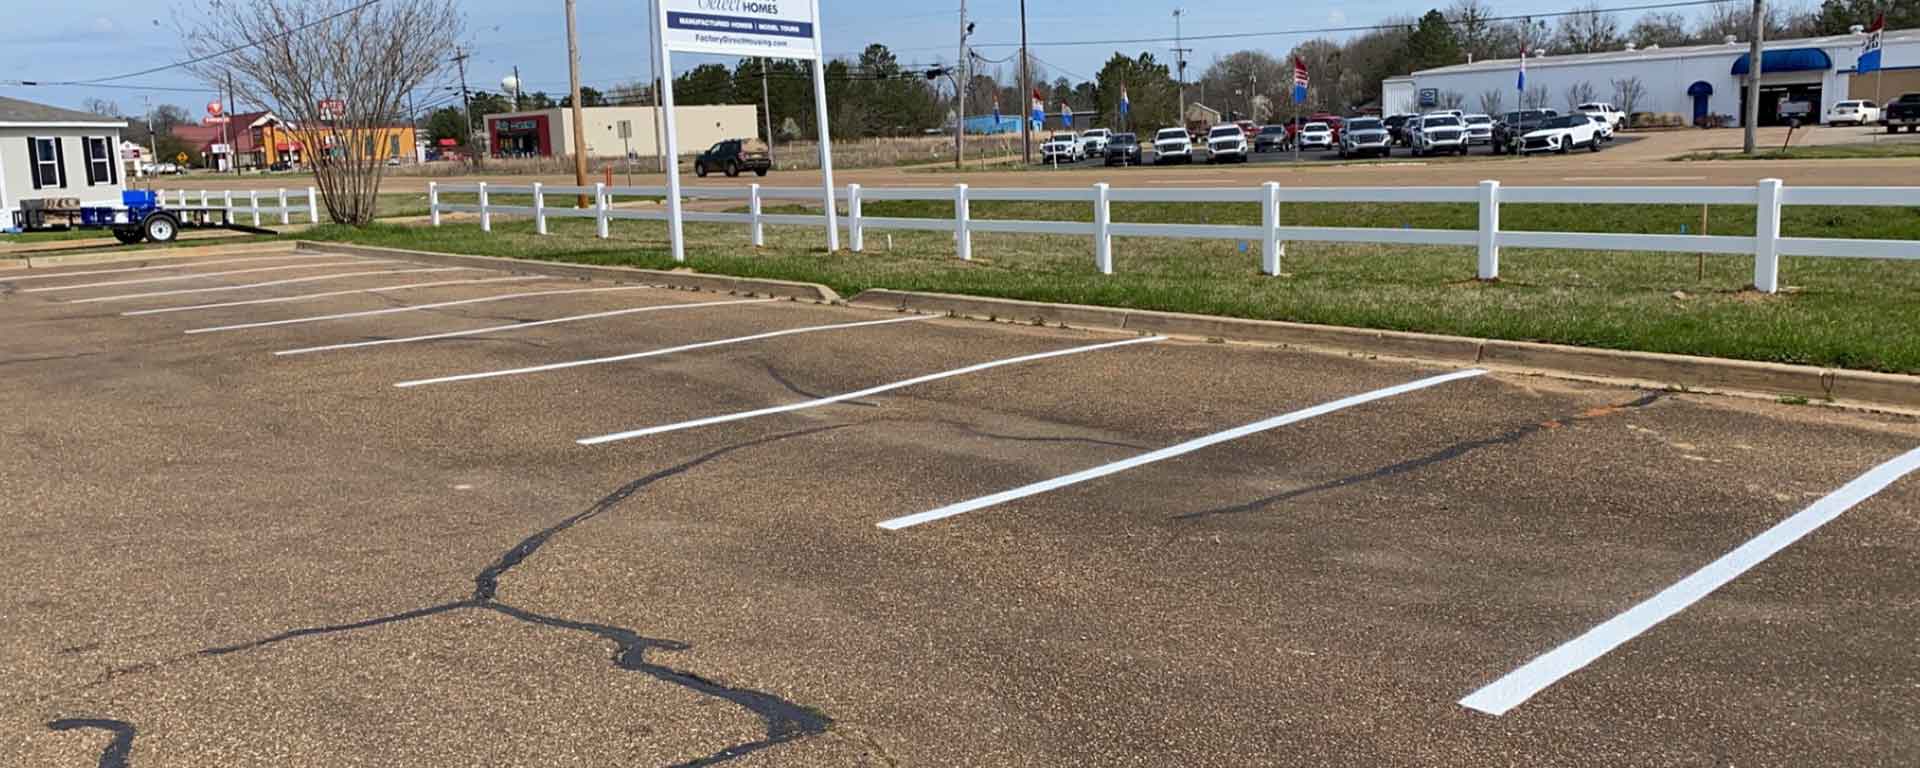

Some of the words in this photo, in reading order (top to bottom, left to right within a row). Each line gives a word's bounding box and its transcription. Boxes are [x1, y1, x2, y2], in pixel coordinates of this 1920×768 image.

[743, 3, 778, 15] HOMES
[679, 17, 730, 28] MANUFACTURED
[731, 21, 753, 30] HOMES
[759, 24, 779, 32] MODEL
[695, 33, 788, 47] FactoryDirectHousing.com
